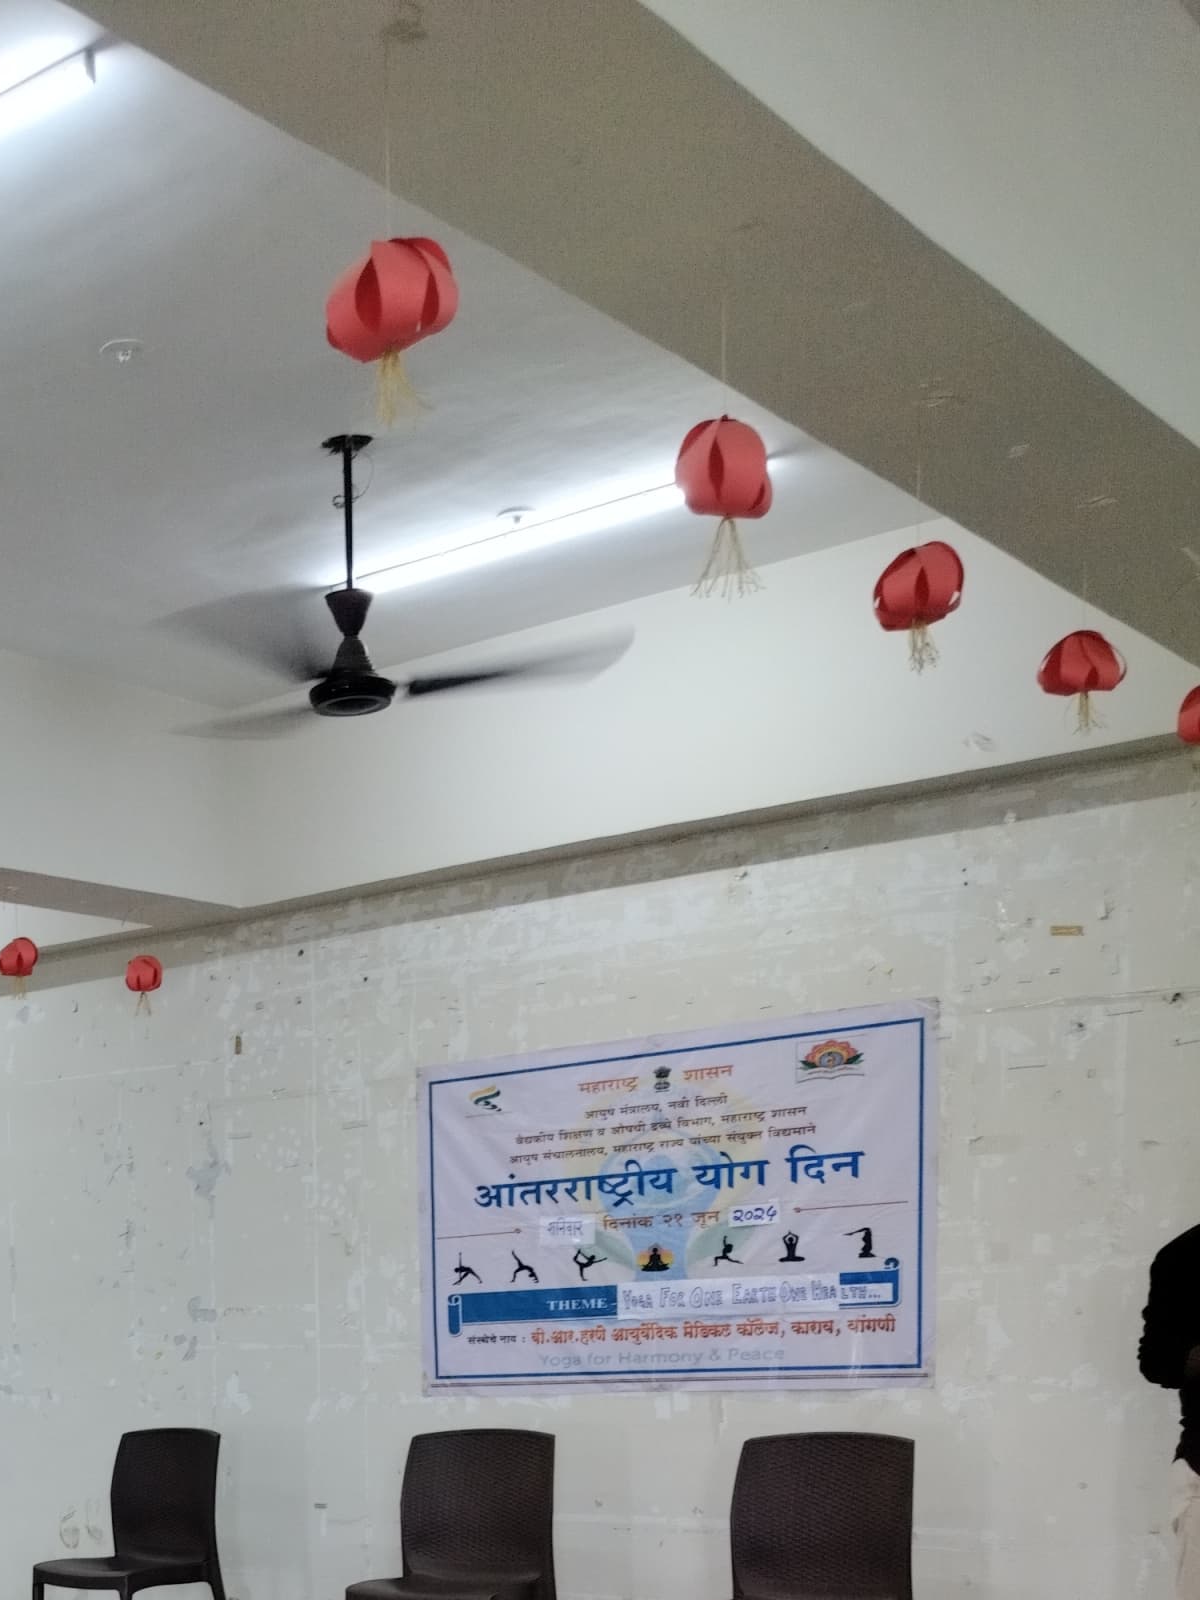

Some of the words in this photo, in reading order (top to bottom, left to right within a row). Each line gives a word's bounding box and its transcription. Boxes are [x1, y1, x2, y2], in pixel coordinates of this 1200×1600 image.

[578, 1076, 639, 1093] महाराष्ट्र
[682, 1065, 734, 1081] शासन
[771, 1106, 808, 1117] शासन
[474, 1159, 678, 1208] आंतरराष्ट्रीय
[691, 1151, 771, 1189] योग
[785, 1144, 865, 1184] दिन
[602, 1212, 654, 1230] दिनांक
[691, 1210, 721, 1229] जून
[541, 1352, 583, 1369] Yoga
[587, 1351, 615, 1365] for
[618, 1350, 703, 1366] Harmony
[709, 1348, 721, 1361] &
[728, 1347, 785, 1361] Peace
